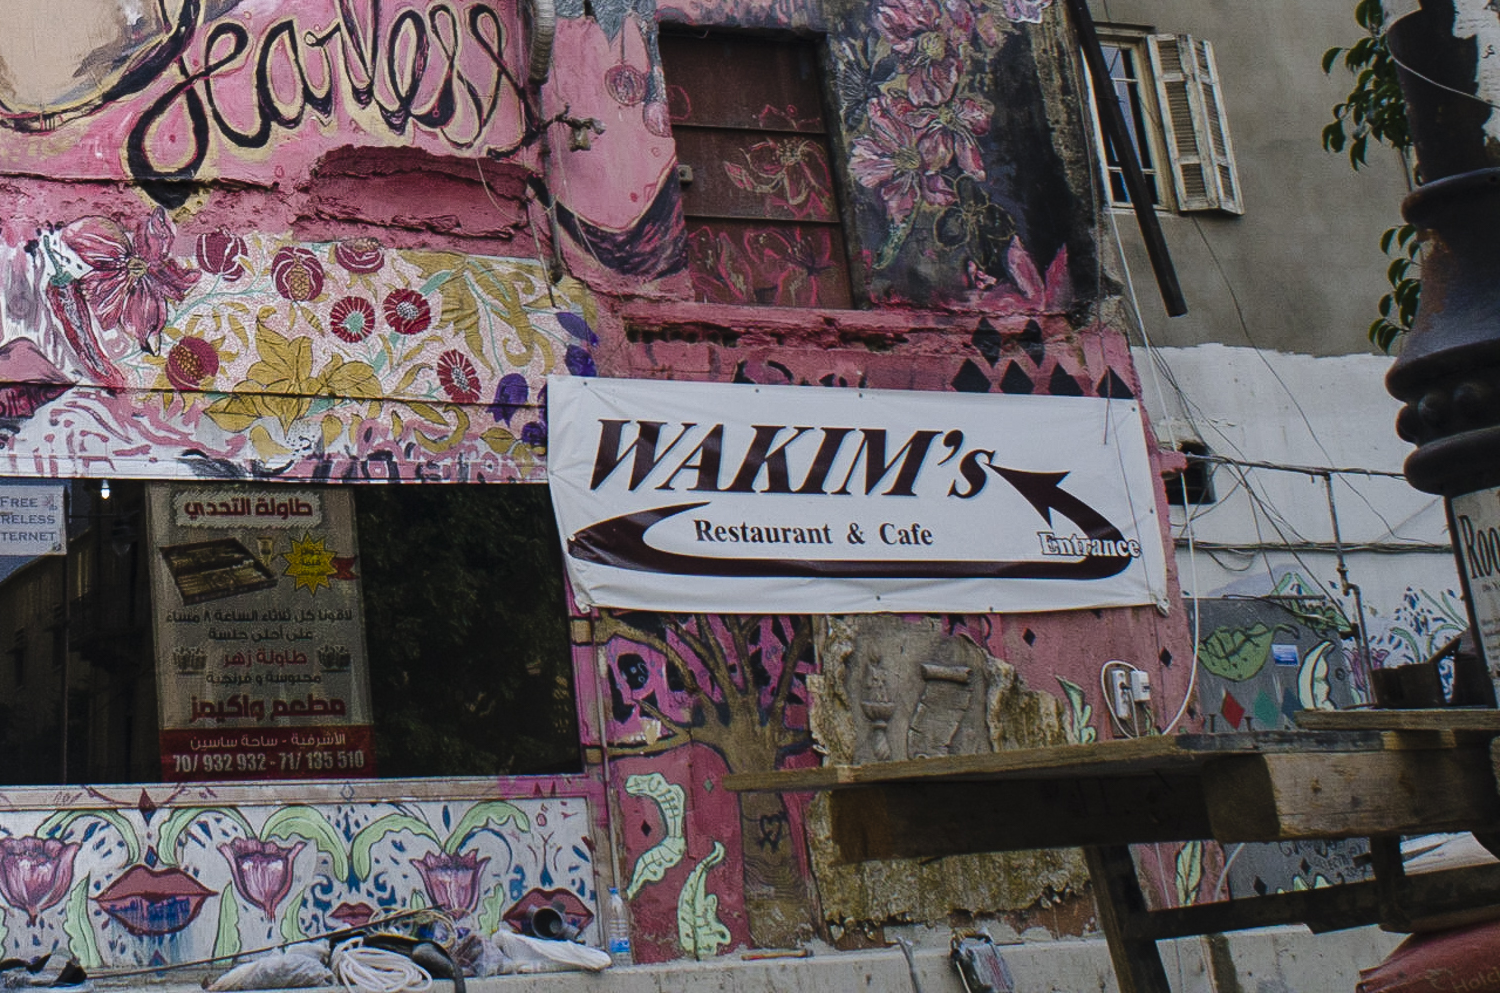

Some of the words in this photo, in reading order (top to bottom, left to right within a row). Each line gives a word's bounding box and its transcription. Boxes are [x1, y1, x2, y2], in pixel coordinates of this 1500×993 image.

[590, 418, 997, 499] WAKIM's
[0, 496, 38, 507] FREE
[184, 496, 251, 521] التحدي
[254, 496, 313, 520] طاولة
[693, 519, 834, 545] Restaurant
[847, 522, 866, 545] &
[879, 522, 934, 546] Cafe
[1036, 531, 1142, 558] Entrance
[214, 609, 258, 623] الساعة
[294, 608, 315, 623] كل
[256, 647, 307, 667] طاولة
[269, 693, 347, 722] مطعم
[190, 735, 238, 751] ساسين
[241, 734, 278, 748] ساحة
[291, 733, 346, 748] الأشرفية
[203, 753, 233, 773] 932
[237, 752, 266, 772] 932
[305, 750, 334, 770] 135
[338, 749, 365, 768] 510
